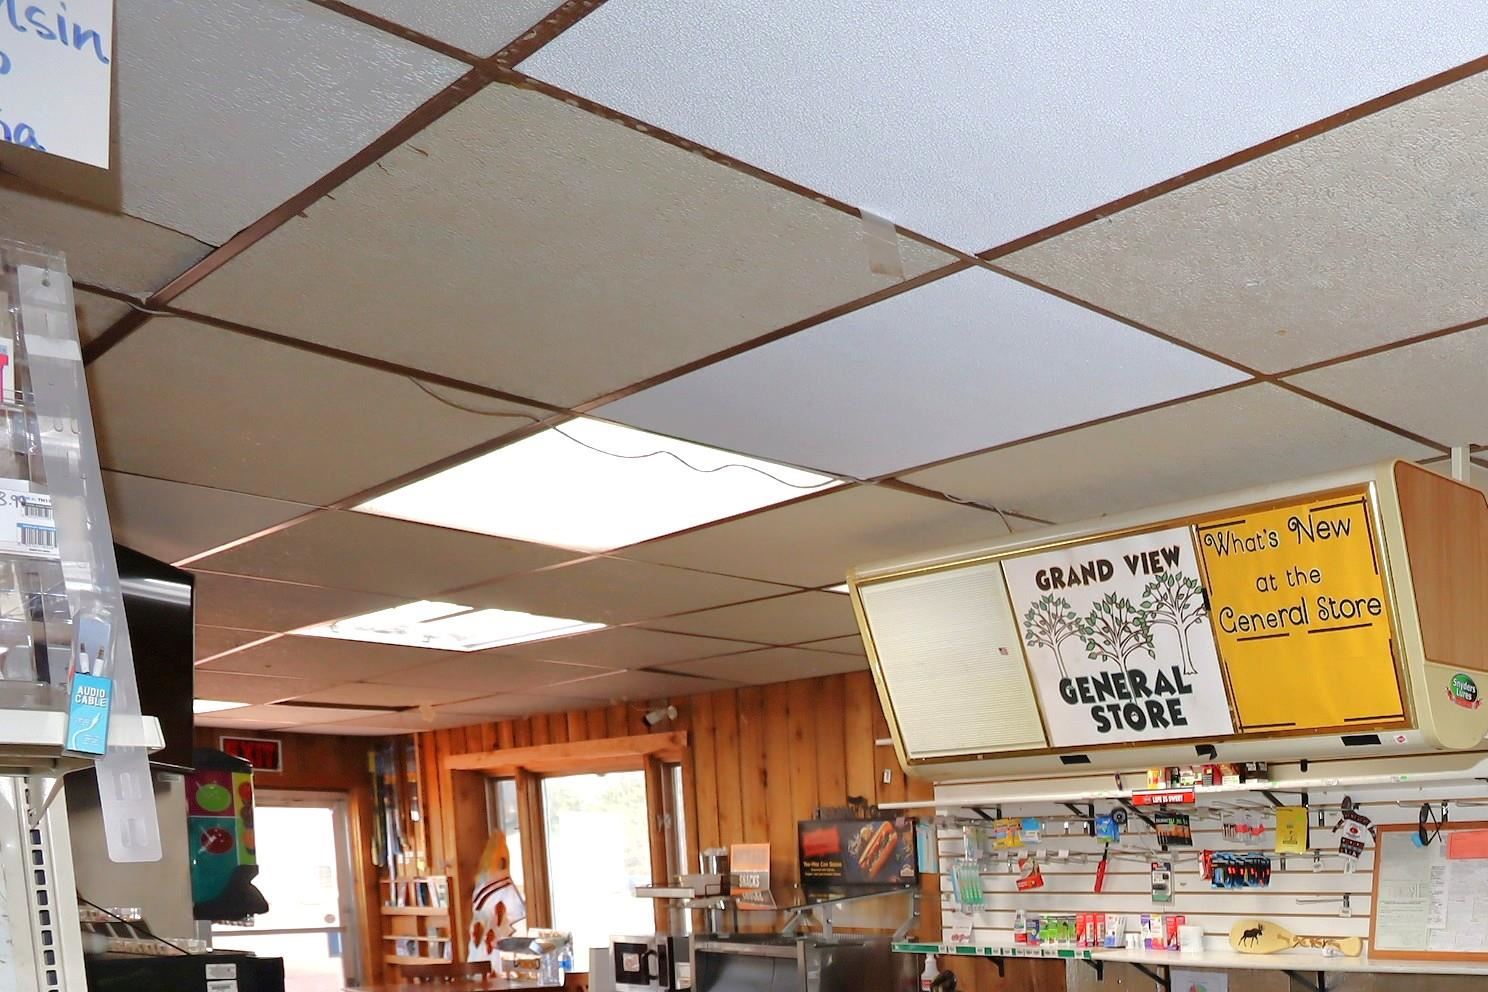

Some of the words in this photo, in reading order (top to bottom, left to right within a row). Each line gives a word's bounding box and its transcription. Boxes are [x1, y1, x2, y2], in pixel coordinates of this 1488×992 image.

[1203, 529, 1279, 557] What's
[1288, 514, 1351, 544] New
[1035, 558, 1114, 591] GRAND
[1123, 545, 1180, 577] VIEW
[1256, 573, 1278, 592] at
[1286, 566, 1321, 587] the
[1219, 597, 1310, 634] General
[1317, 596, 1382, 621] Store
[75, 694, 107, 707] CABLE
[77, 685, 105, 698] AUDIO
[1059, 665, 1193, 705] GENERAL
[1090, 697, 1188, 733] STORE
